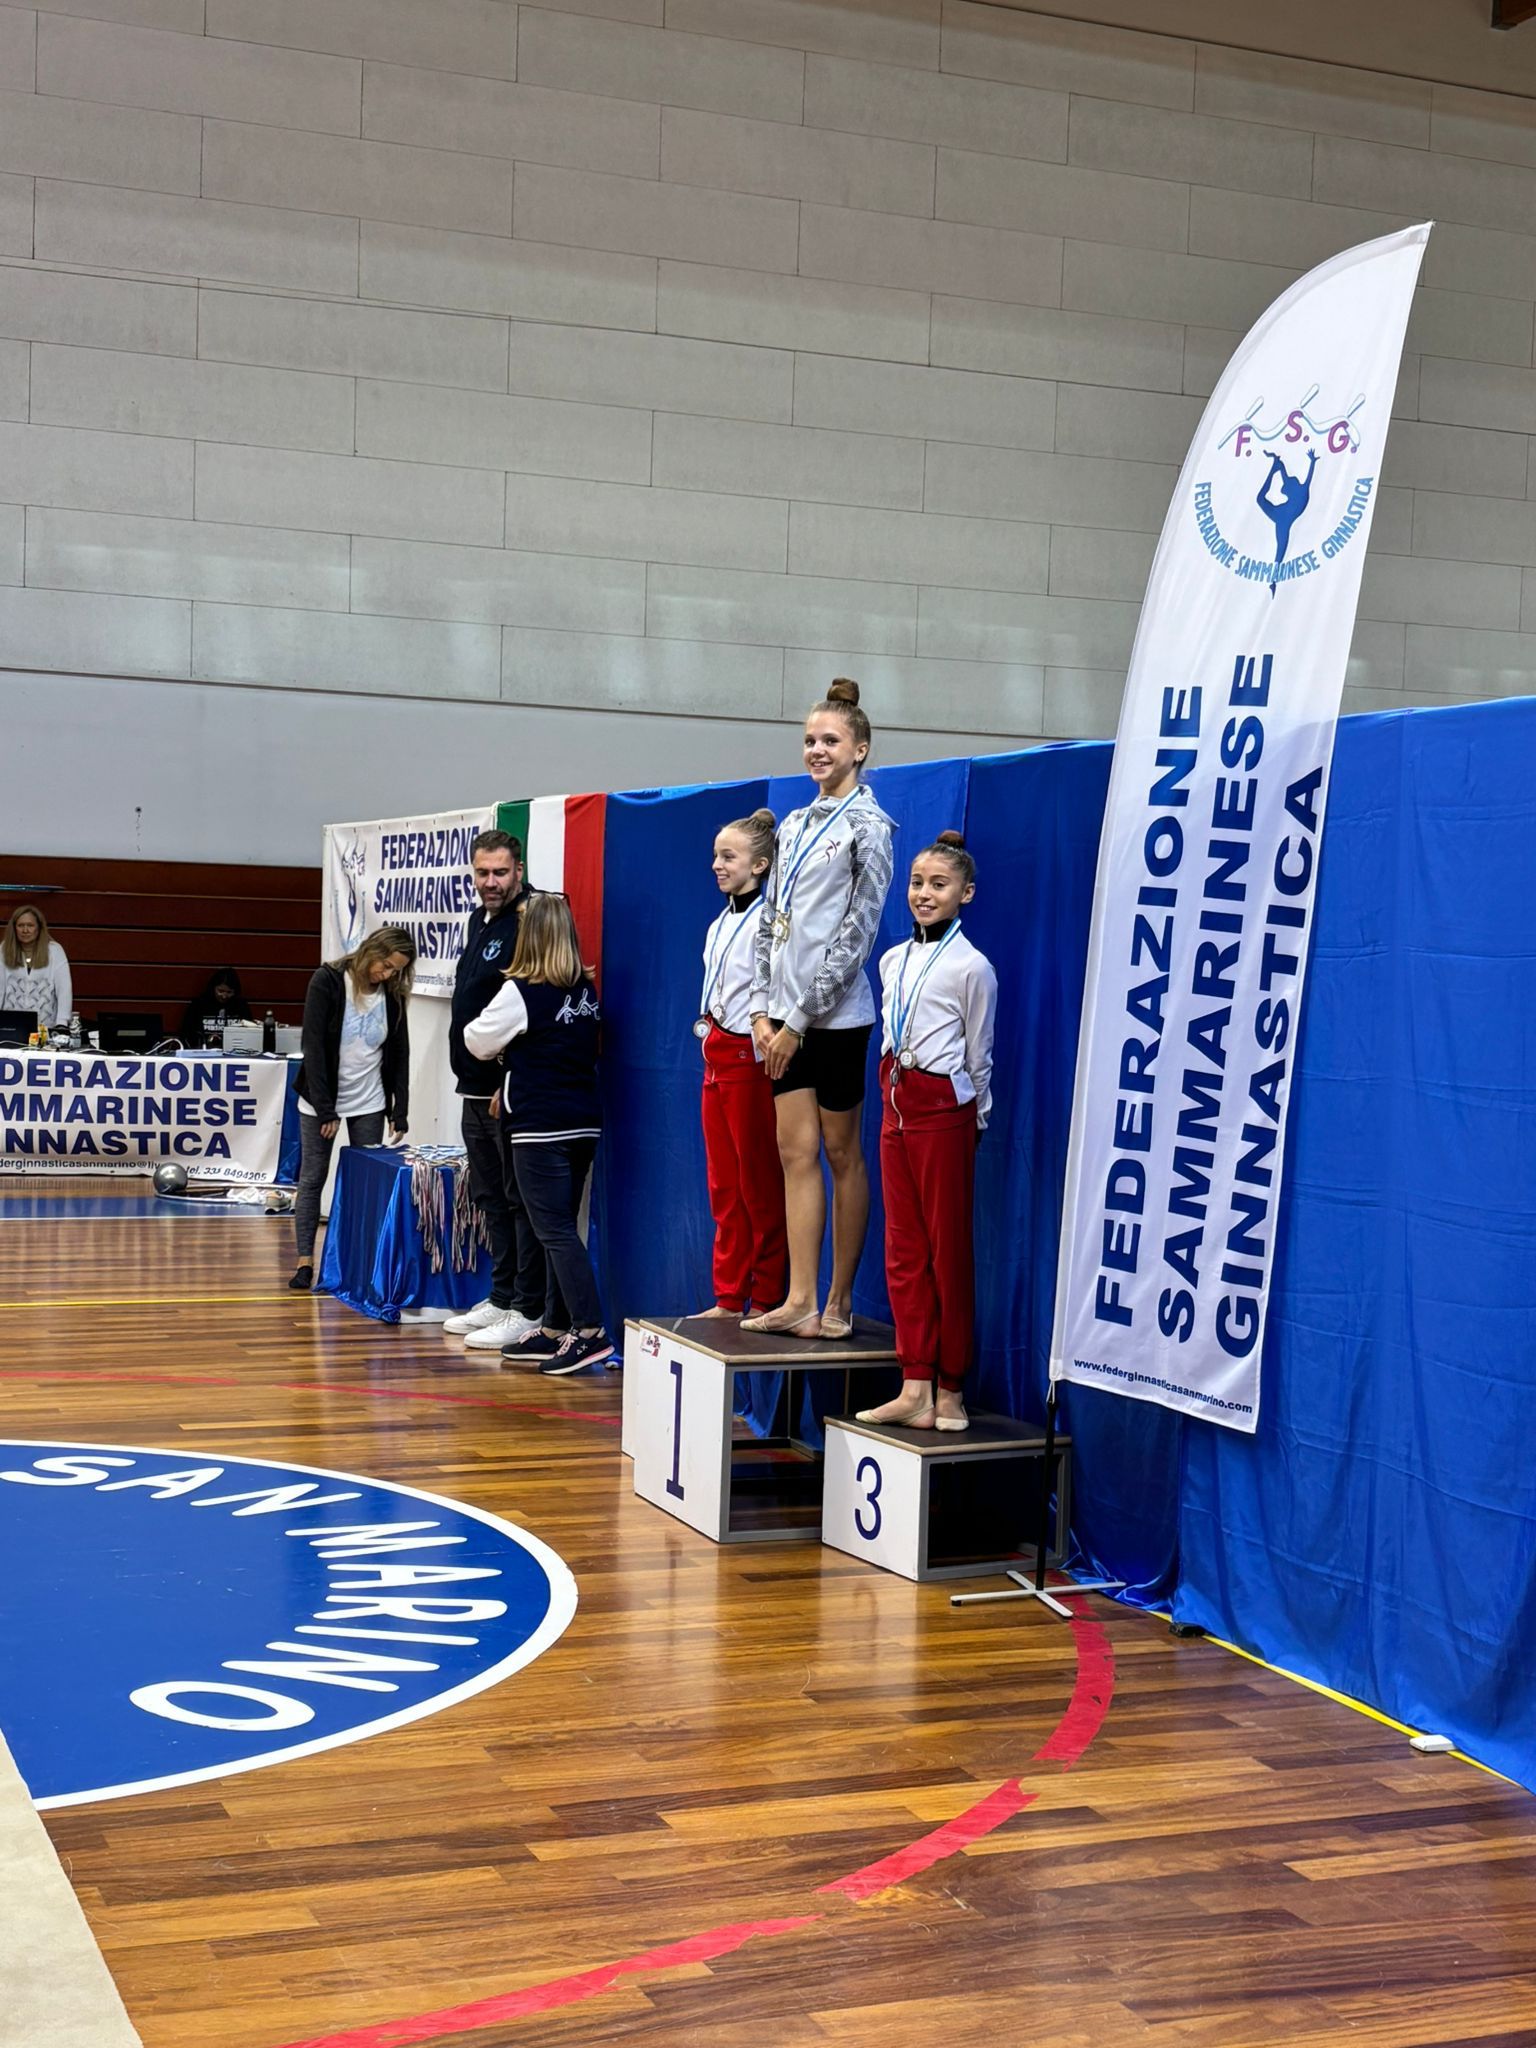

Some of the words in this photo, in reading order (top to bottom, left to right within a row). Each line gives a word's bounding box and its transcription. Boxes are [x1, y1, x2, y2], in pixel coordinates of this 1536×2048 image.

[1195, 481, 1238, 568] FEDERAZIONE
[1235, 550, 1320, 583] SAMMARINESE
[1321, 476, 1374, 559] GINNASTICA
[382, 920, 466, 960] ASTICA
[1096, 685, 1203, 1327] FEDERAZIONE
[1158, 653, 1275, 1343] SAMMARINESE
[0, 1057, 250, 1093] DERAZIONE
[1216, 765, 1324, 1358] GINNASTICA
[0, 1093, 257, 1127] MMARINESE
[5, 1128, 231, 1159] NNASTICA
[1074, 1358, 1253, 1414] www.federginnasticasanmarino.com
[666, 1360, 685, 1501] 1
[0, 1456, 363, 1517] SAN
[854, 1456, 882, 1541] 3
[129, 1521, 508, 1732] MARINO
